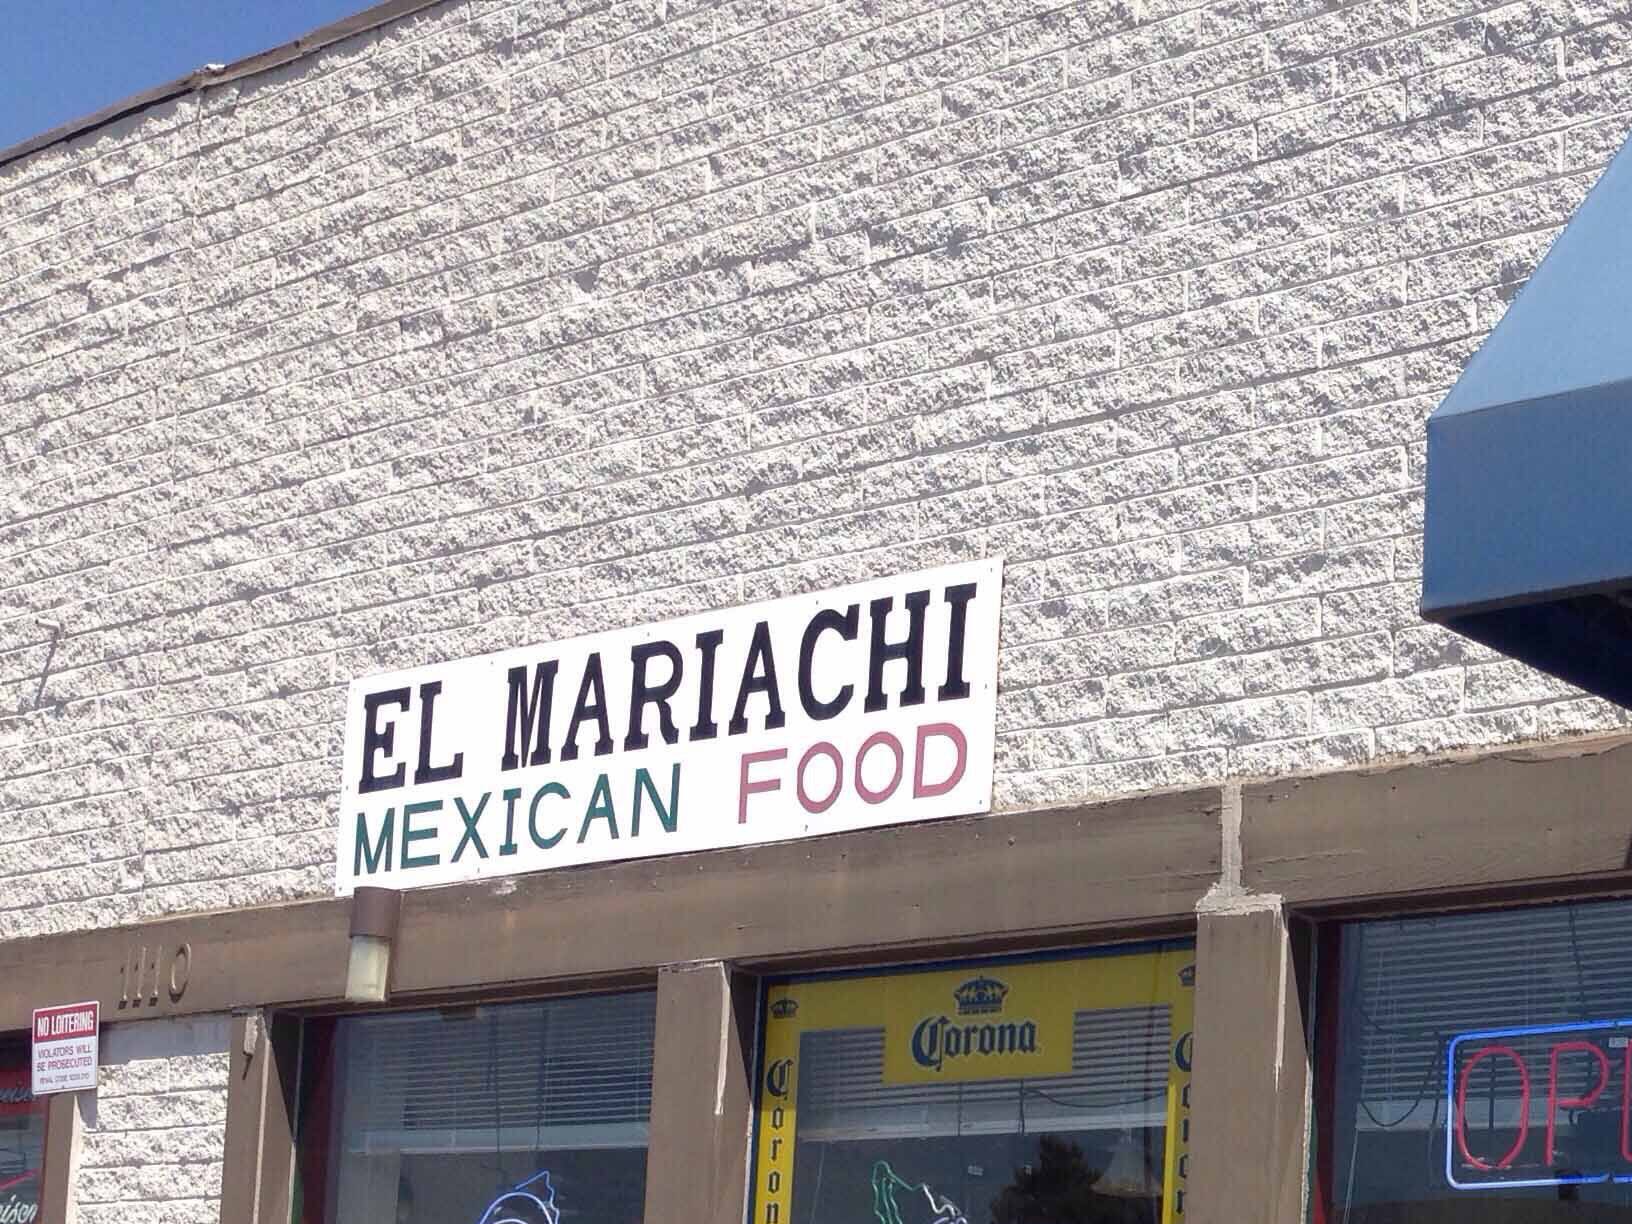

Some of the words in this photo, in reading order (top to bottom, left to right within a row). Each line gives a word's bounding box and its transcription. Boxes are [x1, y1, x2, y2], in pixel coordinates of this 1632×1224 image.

[358, 679, 464, 795] EL
[500, 582, 978, 772] MARIACHI
[353, 762, 682, 876] MEXICAN
[737, 722, 969, 825] FOOD
[119, 942, 193, 1008] 1110
[37, 1016, 50, 1037] NO
[51, 1010, 94, 1036] LOITERING
[38, 1045, 74, 1059] VIOLATORS
[75, 1043, 92, 1054] WILL
[911, 1015, 1038, 1073] Corona
[37, 1061, 47, 1072] BE
[47, 1056, 93, 1070] PROSECUTED
